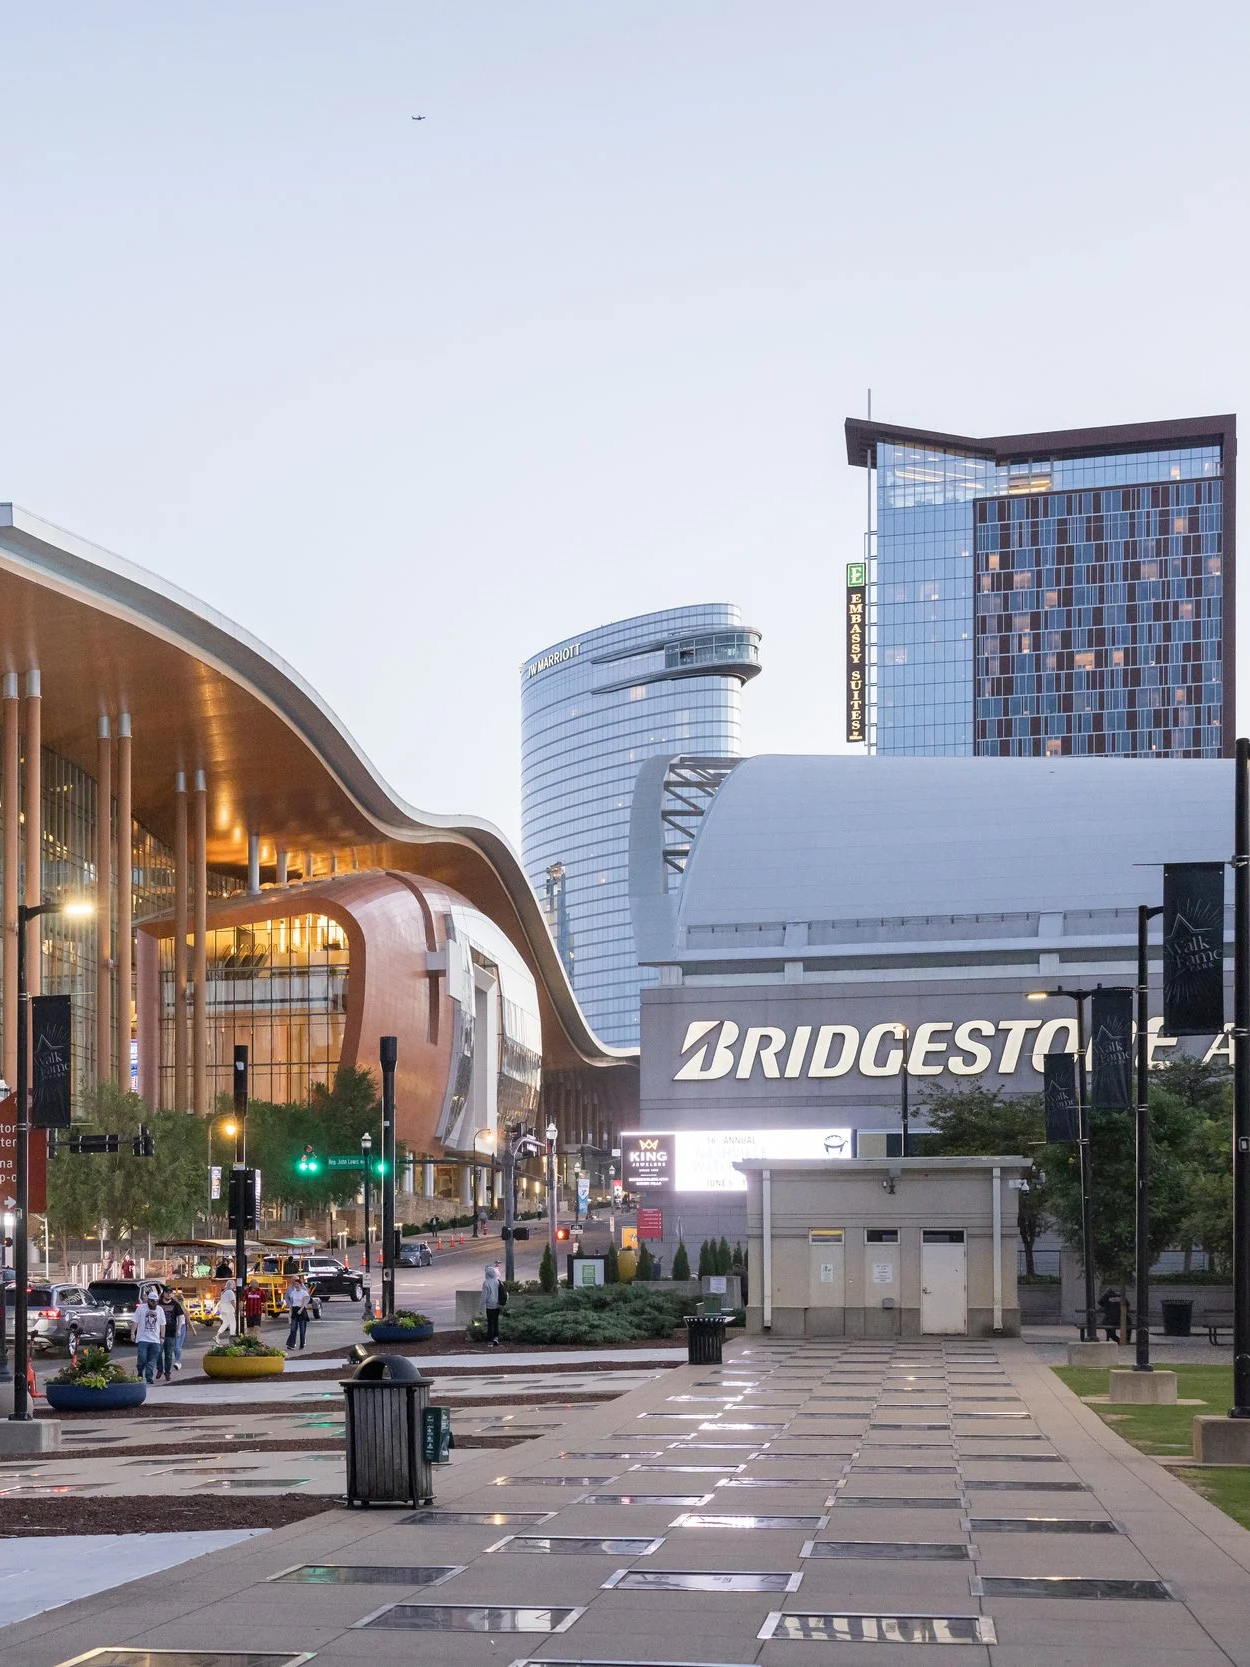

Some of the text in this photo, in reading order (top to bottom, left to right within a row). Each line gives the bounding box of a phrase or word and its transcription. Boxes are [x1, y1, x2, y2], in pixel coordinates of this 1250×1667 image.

[849, 593, 864, 664] EMBASSY
[527, 643, 581, 679] JW MARRIOTT
[849, 670, 863, 730] SUITES
[1164, 935, 1210, 956] Walk
[1176, 949, 1223, 968] Fame
[673, 1018, 1178, 1080] BRIDGESTOE
[723, 1136, 756, 1145] ANNUAL
[630, 1151, 668, 1162] KING
